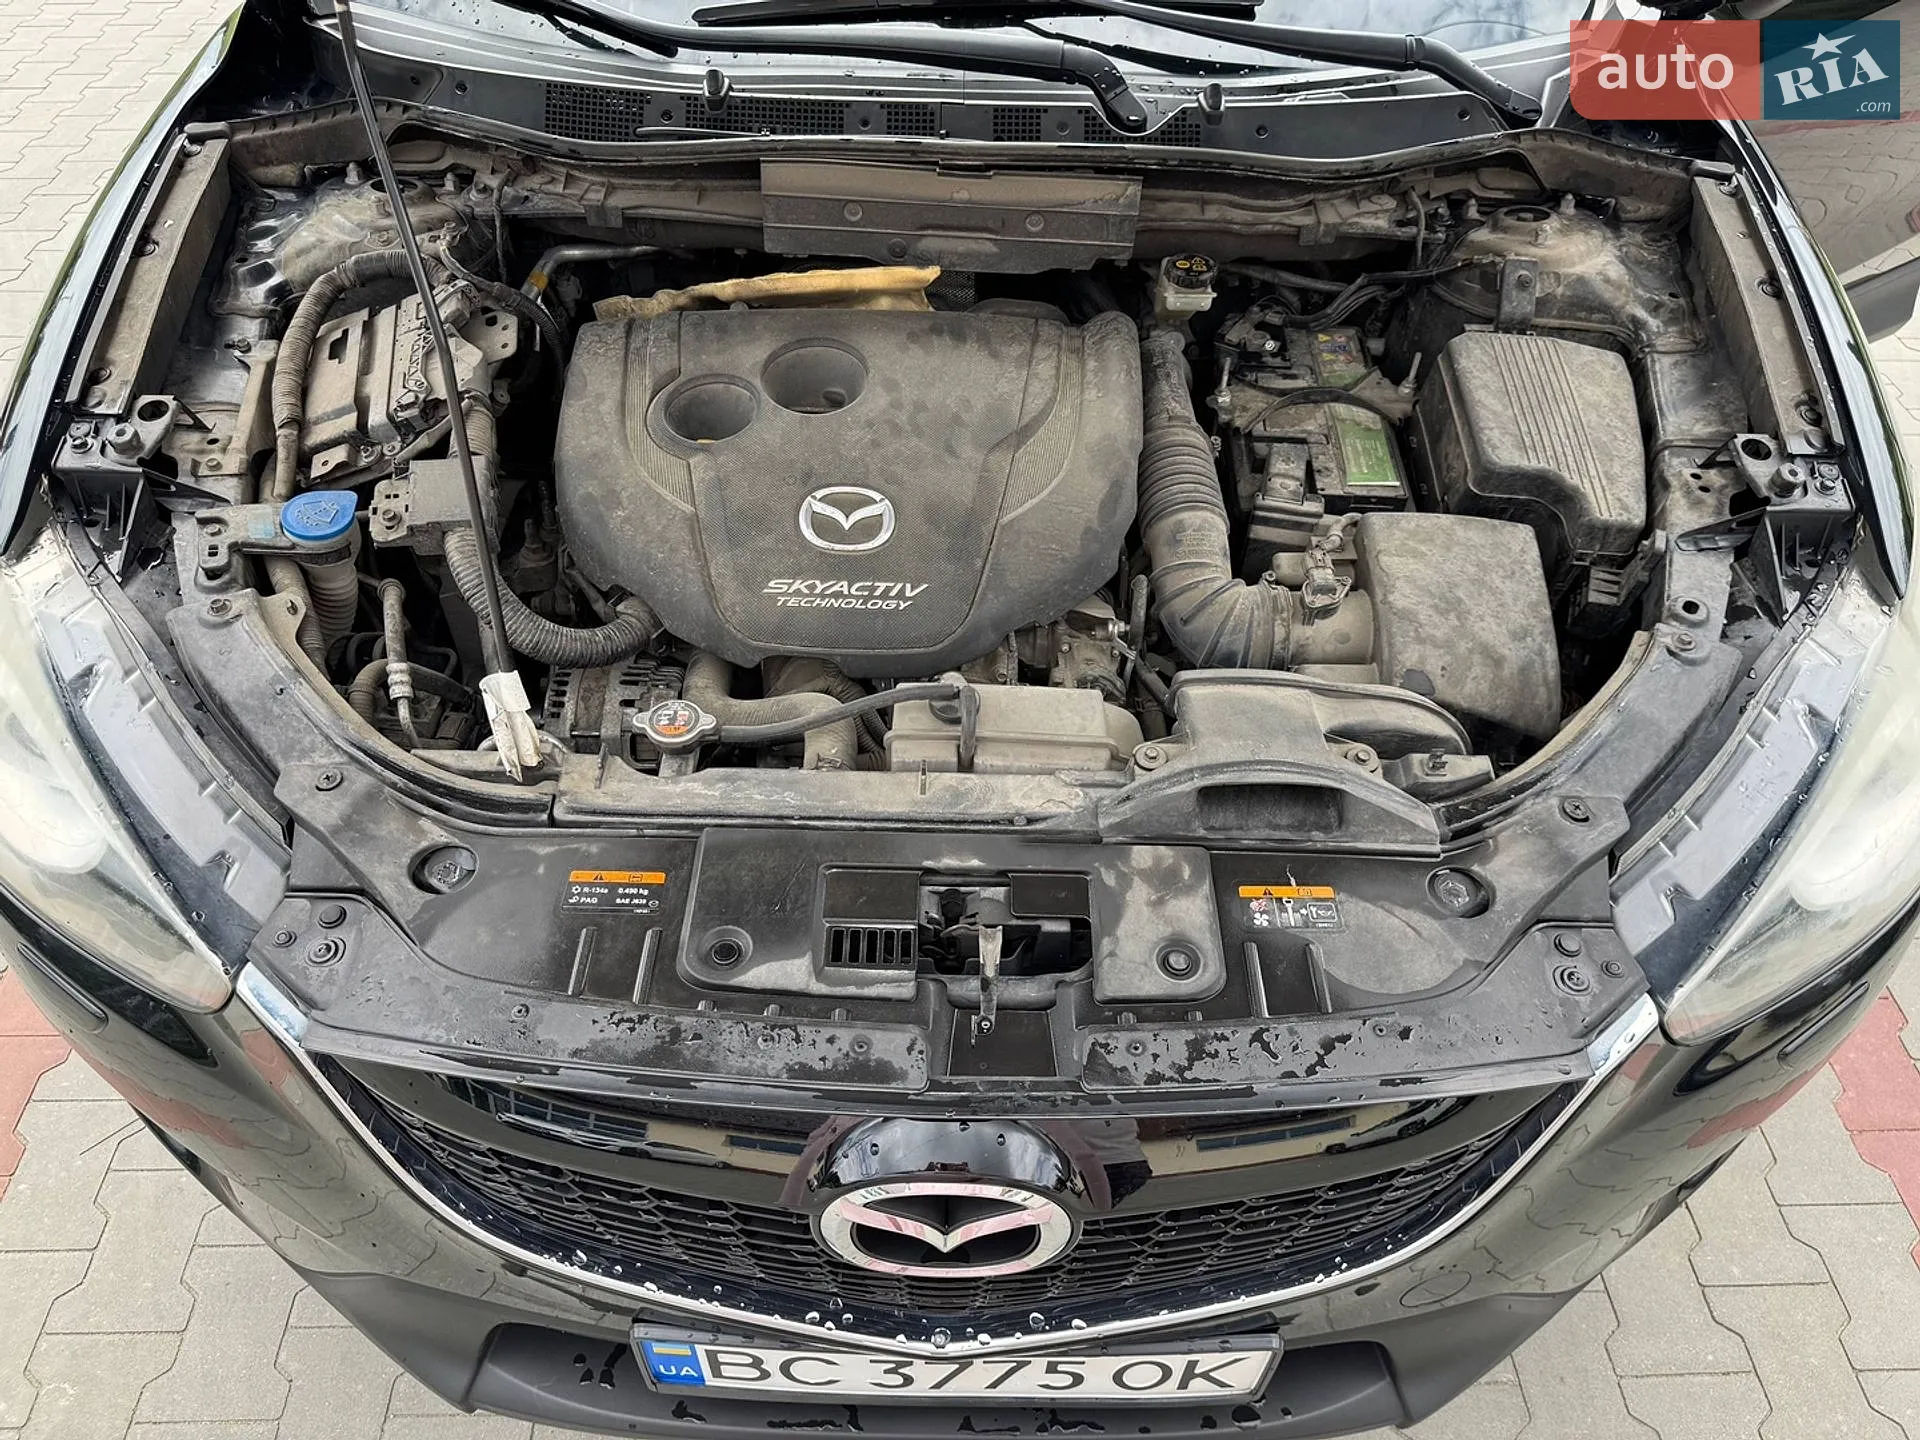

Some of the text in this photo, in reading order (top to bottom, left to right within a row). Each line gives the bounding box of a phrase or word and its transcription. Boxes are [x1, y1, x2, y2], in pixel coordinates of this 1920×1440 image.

[762, 579, 929, 598] SKYACTIV
[776, 596, 913, 611] TECHNOLOGY
[658, 1363, 699, 1377] UA
[703, 1348, 1251, 1391] BC 3775 OK
